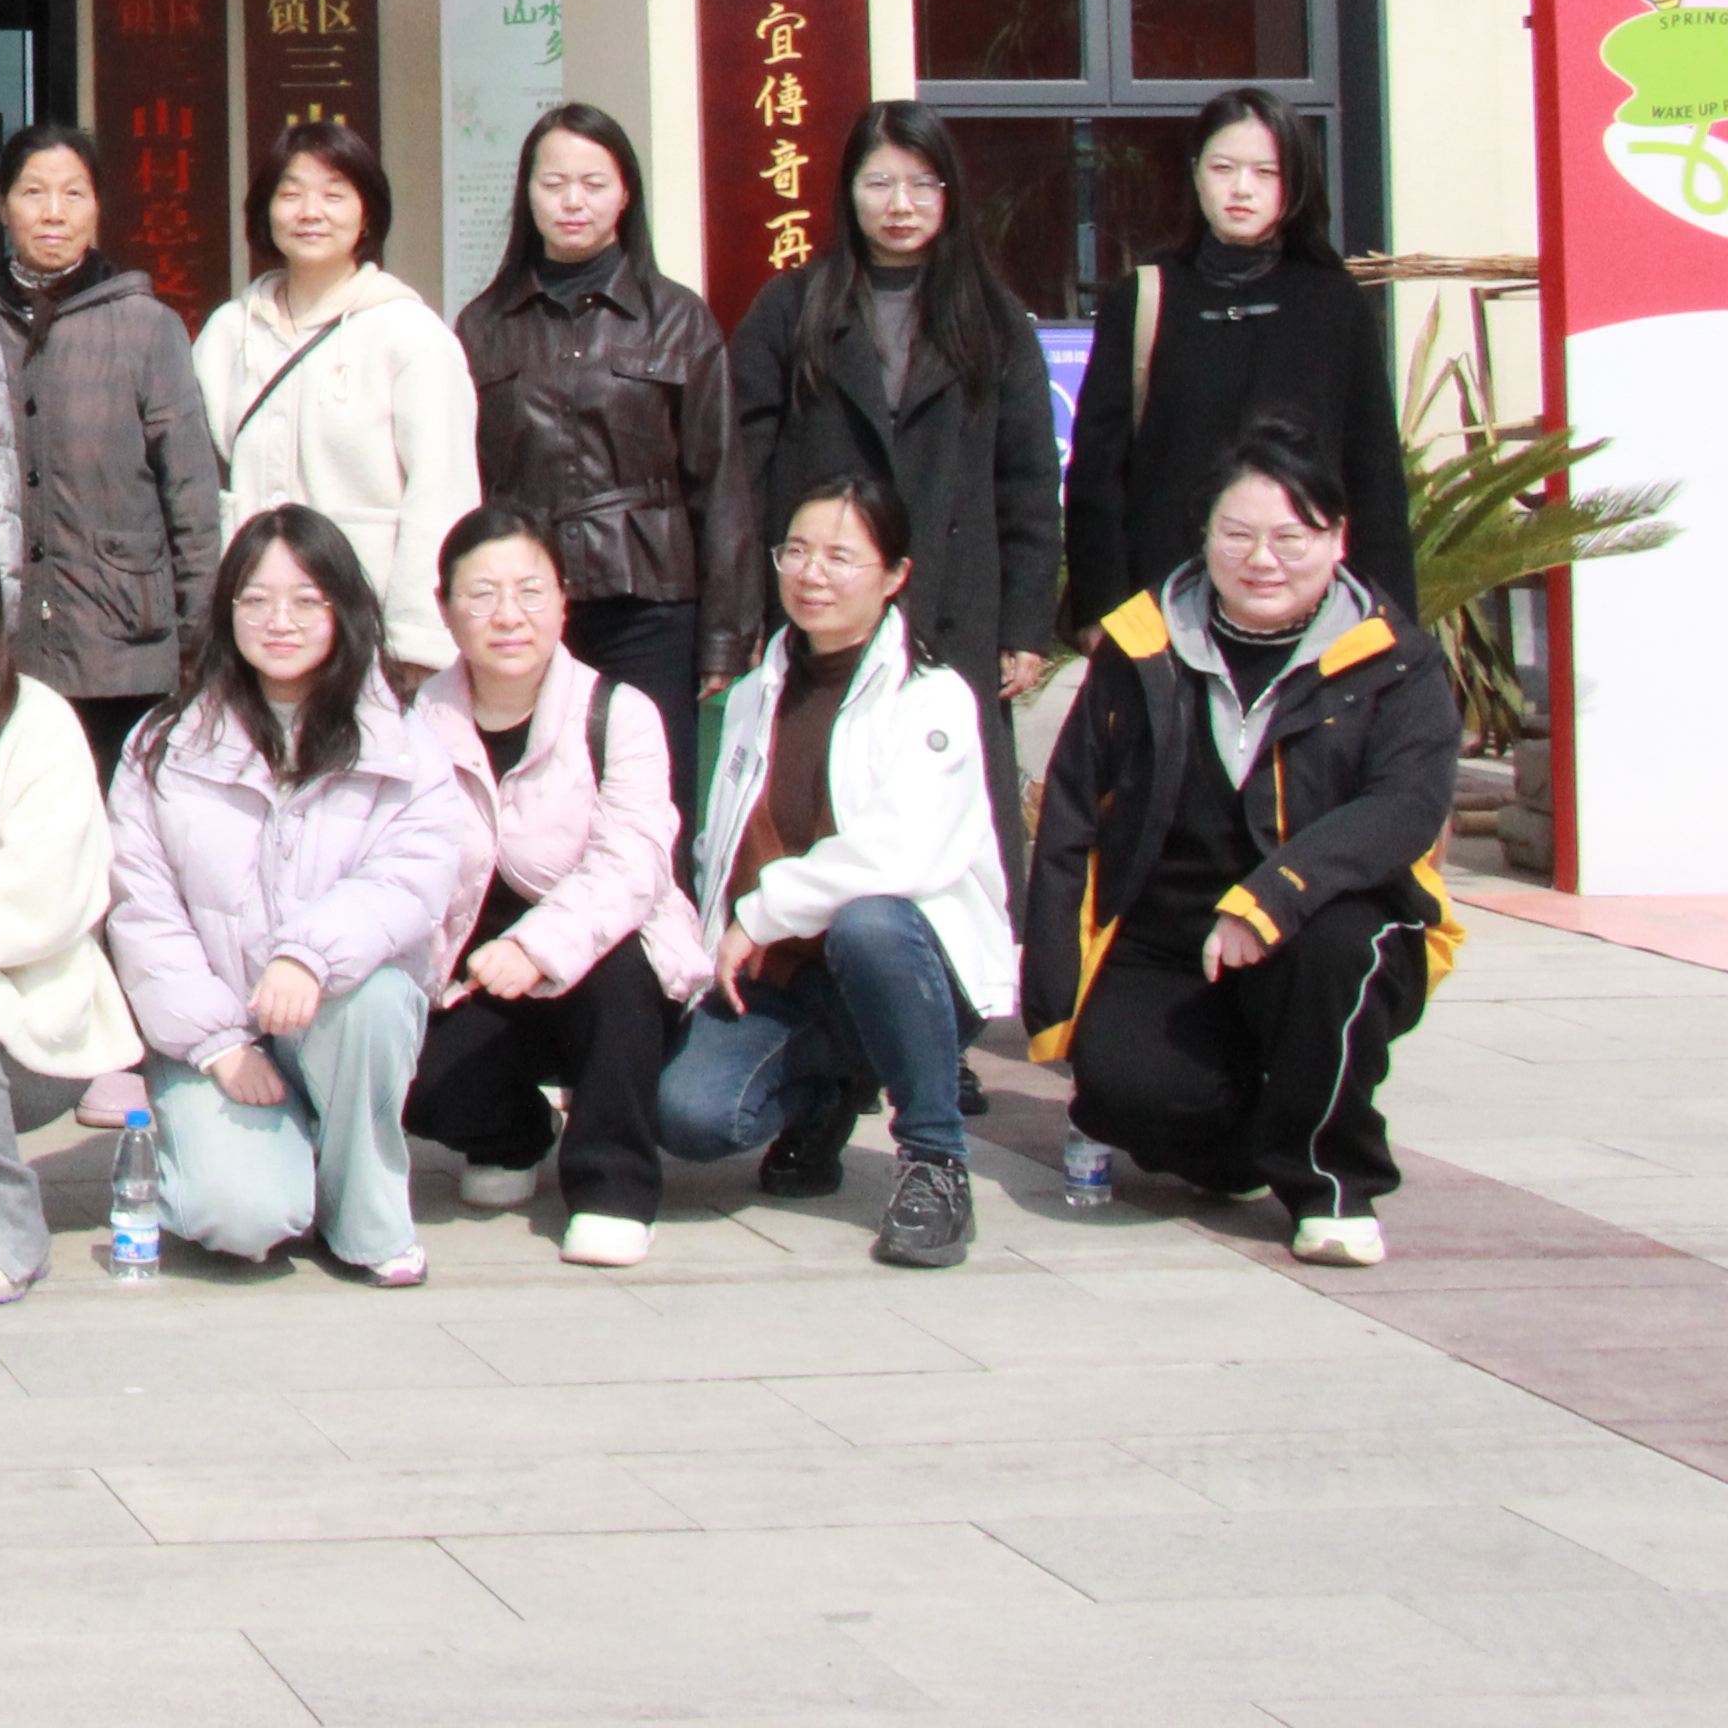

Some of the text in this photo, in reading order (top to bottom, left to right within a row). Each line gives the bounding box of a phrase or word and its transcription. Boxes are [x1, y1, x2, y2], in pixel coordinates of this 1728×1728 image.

[1659, 12, 1728, 30] SPRING
[1651, 105, 1693, 119] WAKE
[1698, 102, 1718, 116] UP
